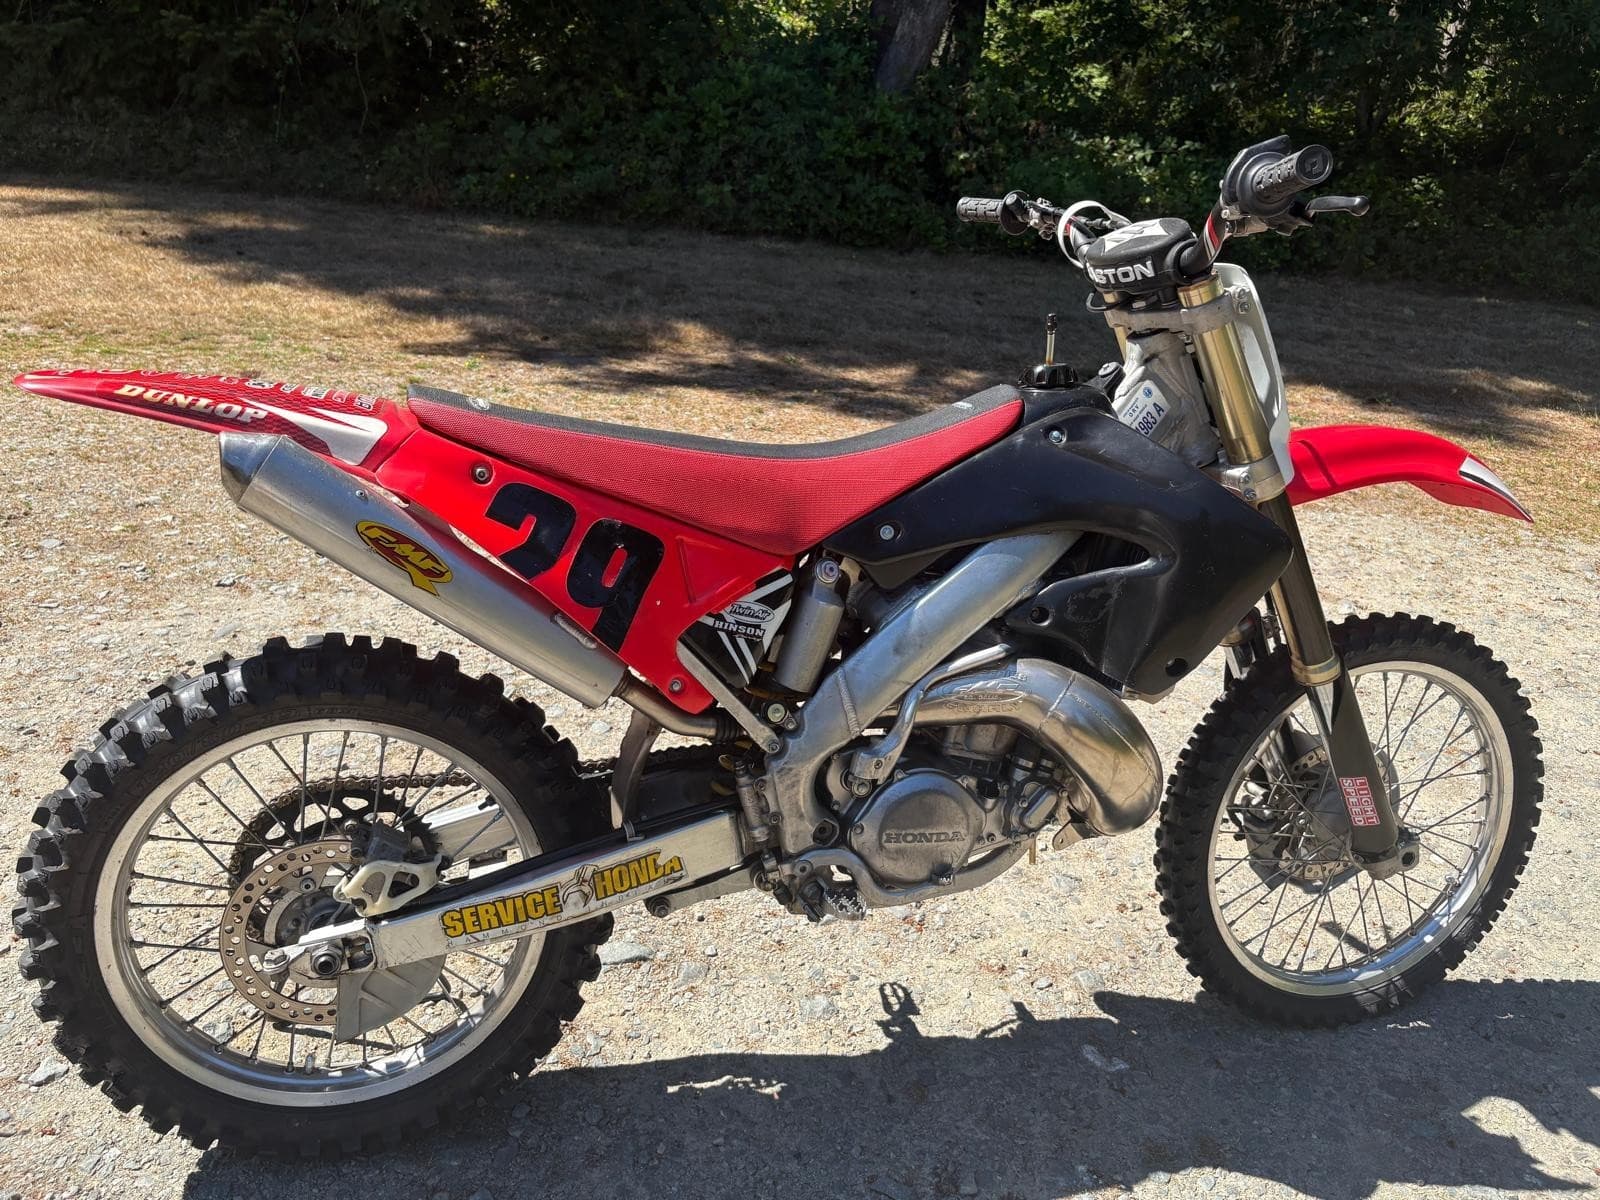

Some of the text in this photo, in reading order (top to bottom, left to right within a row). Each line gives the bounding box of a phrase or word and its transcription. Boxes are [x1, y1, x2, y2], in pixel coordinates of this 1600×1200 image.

[112, 384, 268, 423] DUNLOP
[1152, 402, 1165, 418] A
[359, 525, 451, 577] FMF
[485, 481, 665, 653] 29
[714, 619, 765, 638] HINSON
[730, 602, 756, 618] Twin
[1342, 779, 1365, 826] SPEED
[1355, 778, 1378, 825] LIGHT
[883, 831, 966, 844] HONDA
[441, 885, 564, 938] SERVICE
